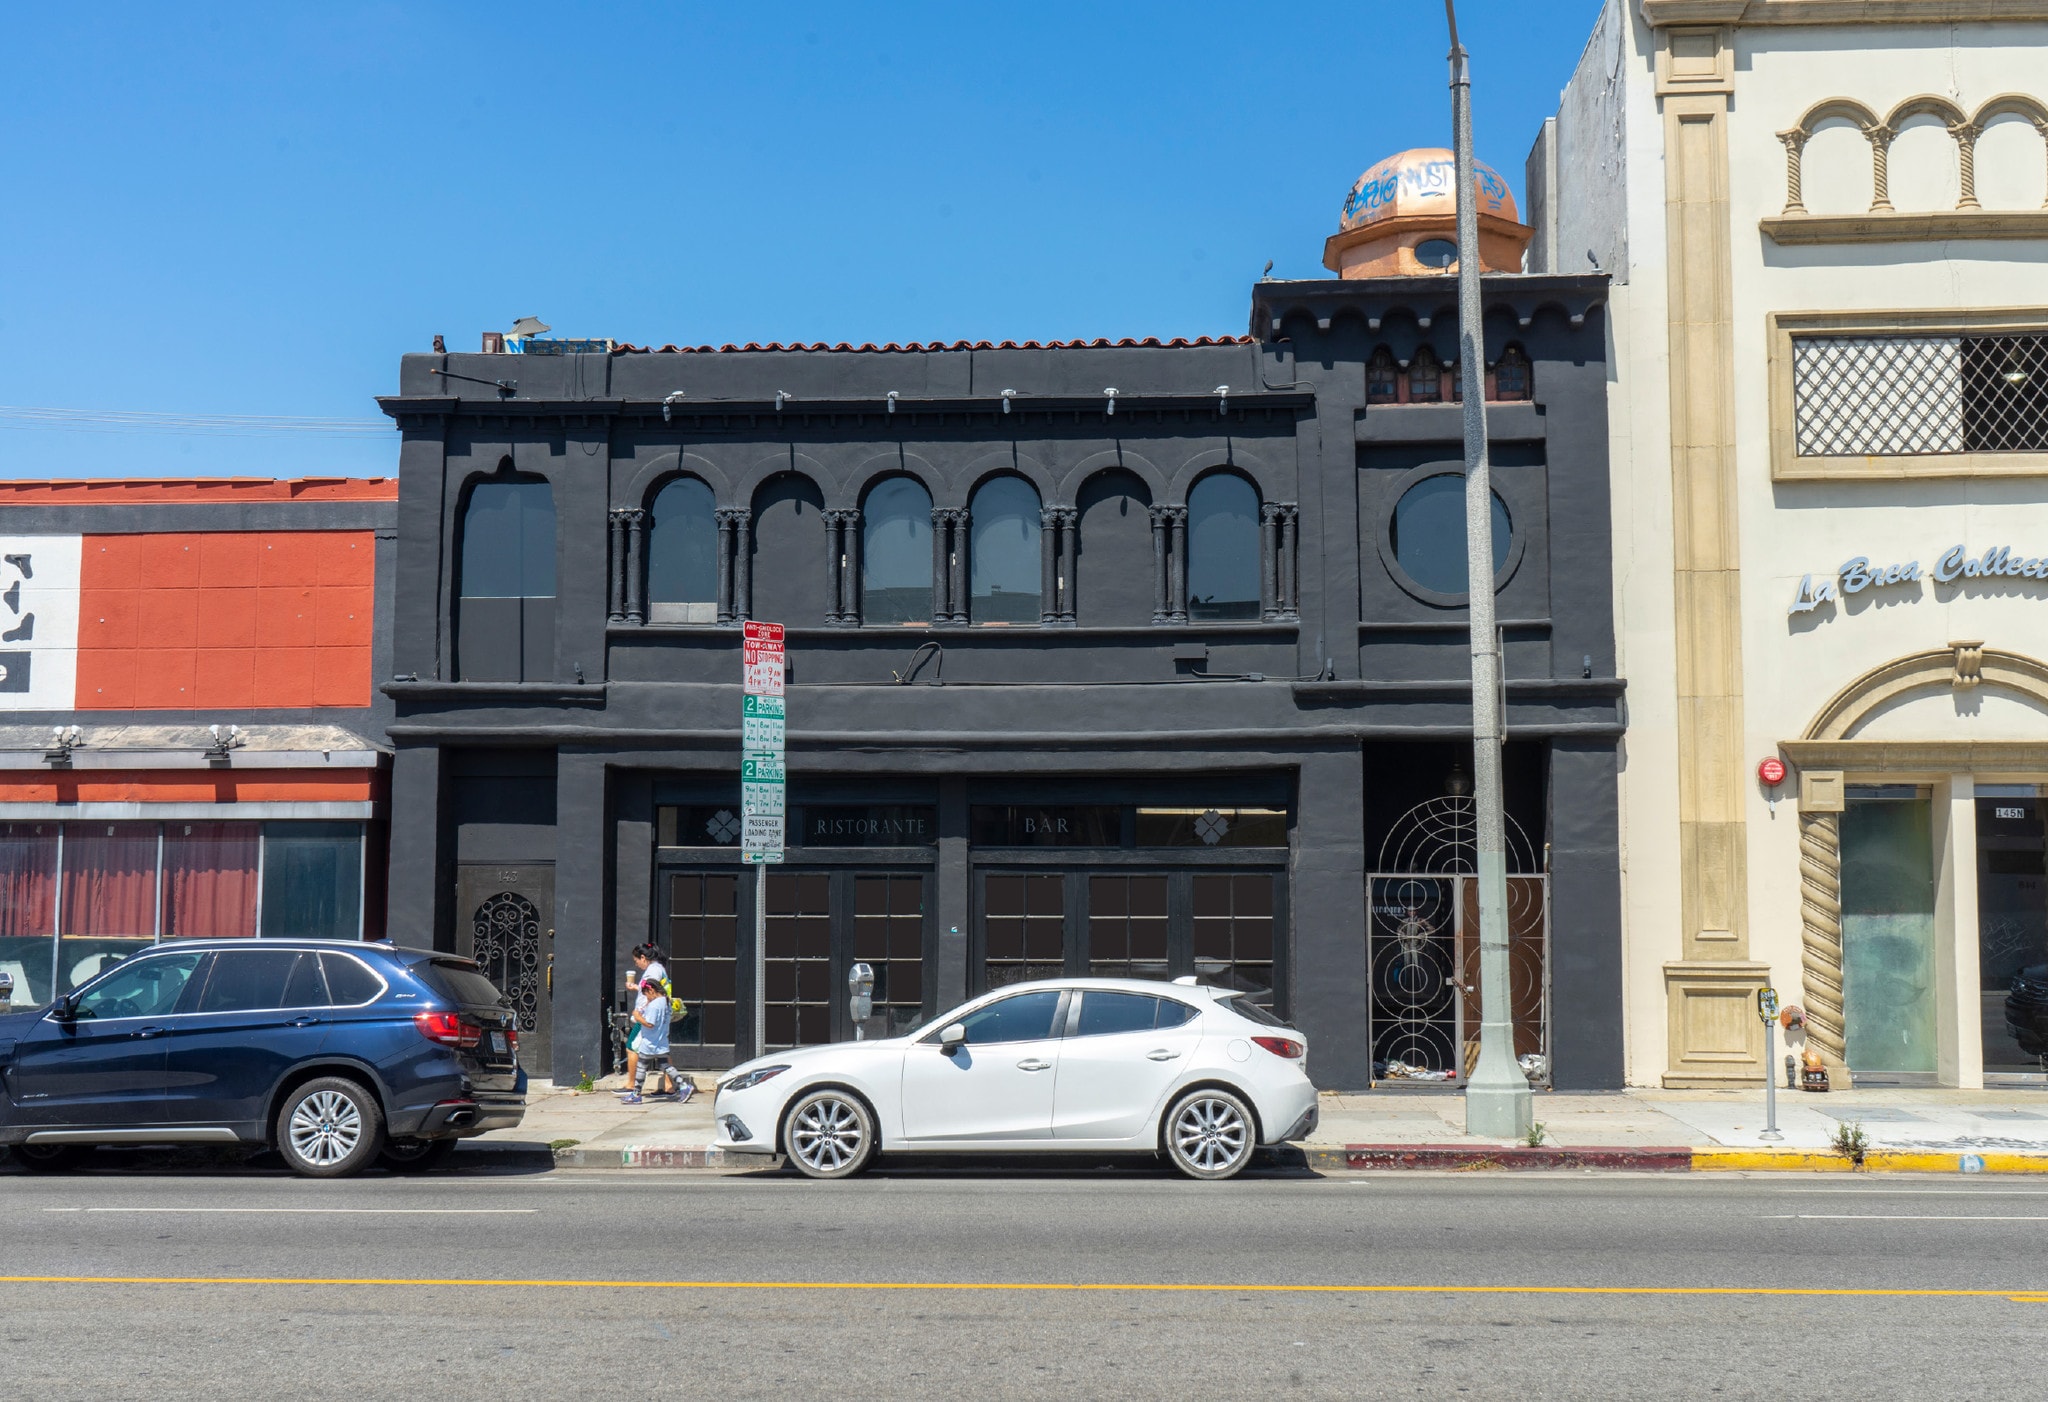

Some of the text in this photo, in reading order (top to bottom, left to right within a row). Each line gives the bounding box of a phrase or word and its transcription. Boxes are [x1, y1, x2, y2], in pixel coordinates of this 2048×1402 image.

[1788, 573, 1837, 616] La
[1839, 556, 1924, 593] Brea
[746, 624, 782, 633] ANTI-GRIDLOCK
[758, 630, 771, 638] ZONE
[745, 649, 784, 664] NO STOPPING
[746, 697, 754, 711] 2
[758, 703, 783, 714] PARKING
[745, 762, 754, 776] 2
[758, 768, 783, 779] PARKING
[1997, 808, 2024, 818] 145N
[748, 819, 779, 828] PASSENGER
[816, 819, 926, 834] RISTORANTE
[1025, 817, 1069, 833] BAR
[744, 828, 767, 837] LOADING
[645, 1151, 693, 1167] 143 N
